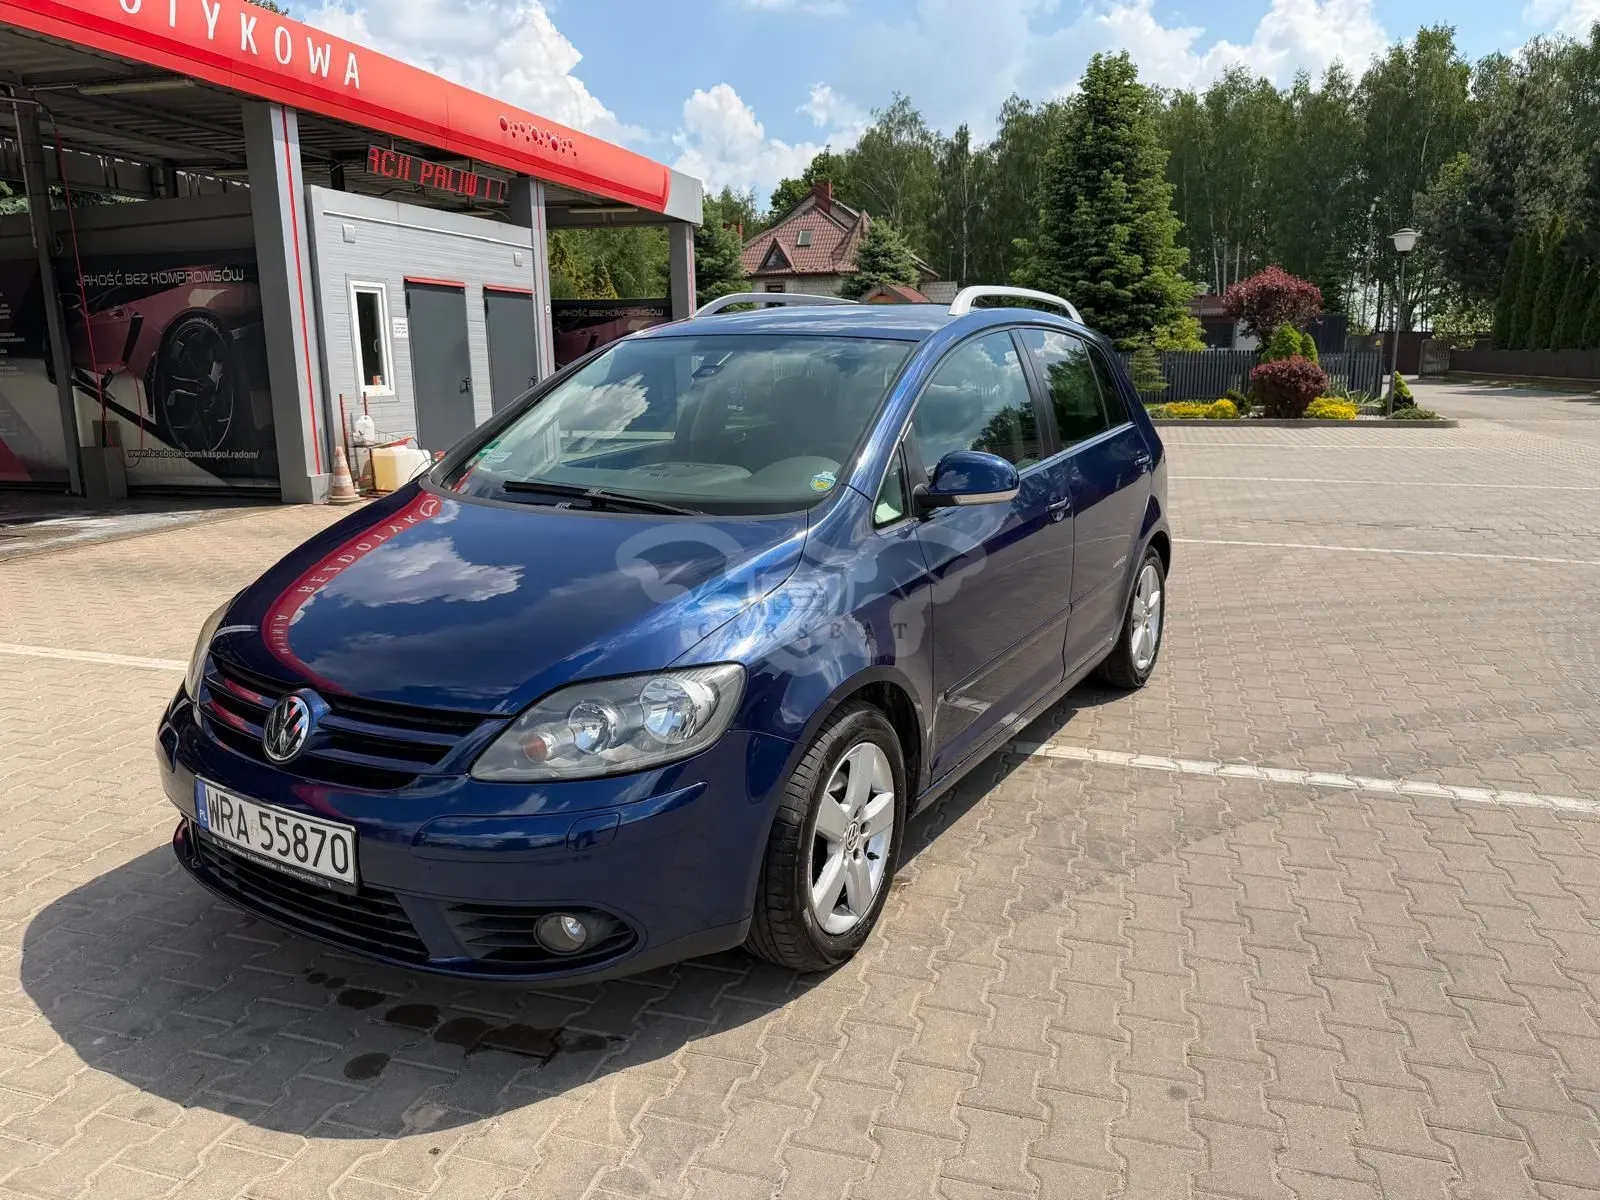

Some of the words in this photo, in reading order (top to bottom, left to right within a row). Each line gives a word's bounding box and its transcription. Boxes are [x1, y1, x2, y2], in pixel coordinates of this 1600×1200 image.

[76, 269, 123, 287] JAKOŚĆ
[125, 273, 149, 286] BEZ
[151, 266, 244, 286] KOMPROMISÓW
[208, 793, 251, 844] WRA
[259, 812, 348, 873] 55870
